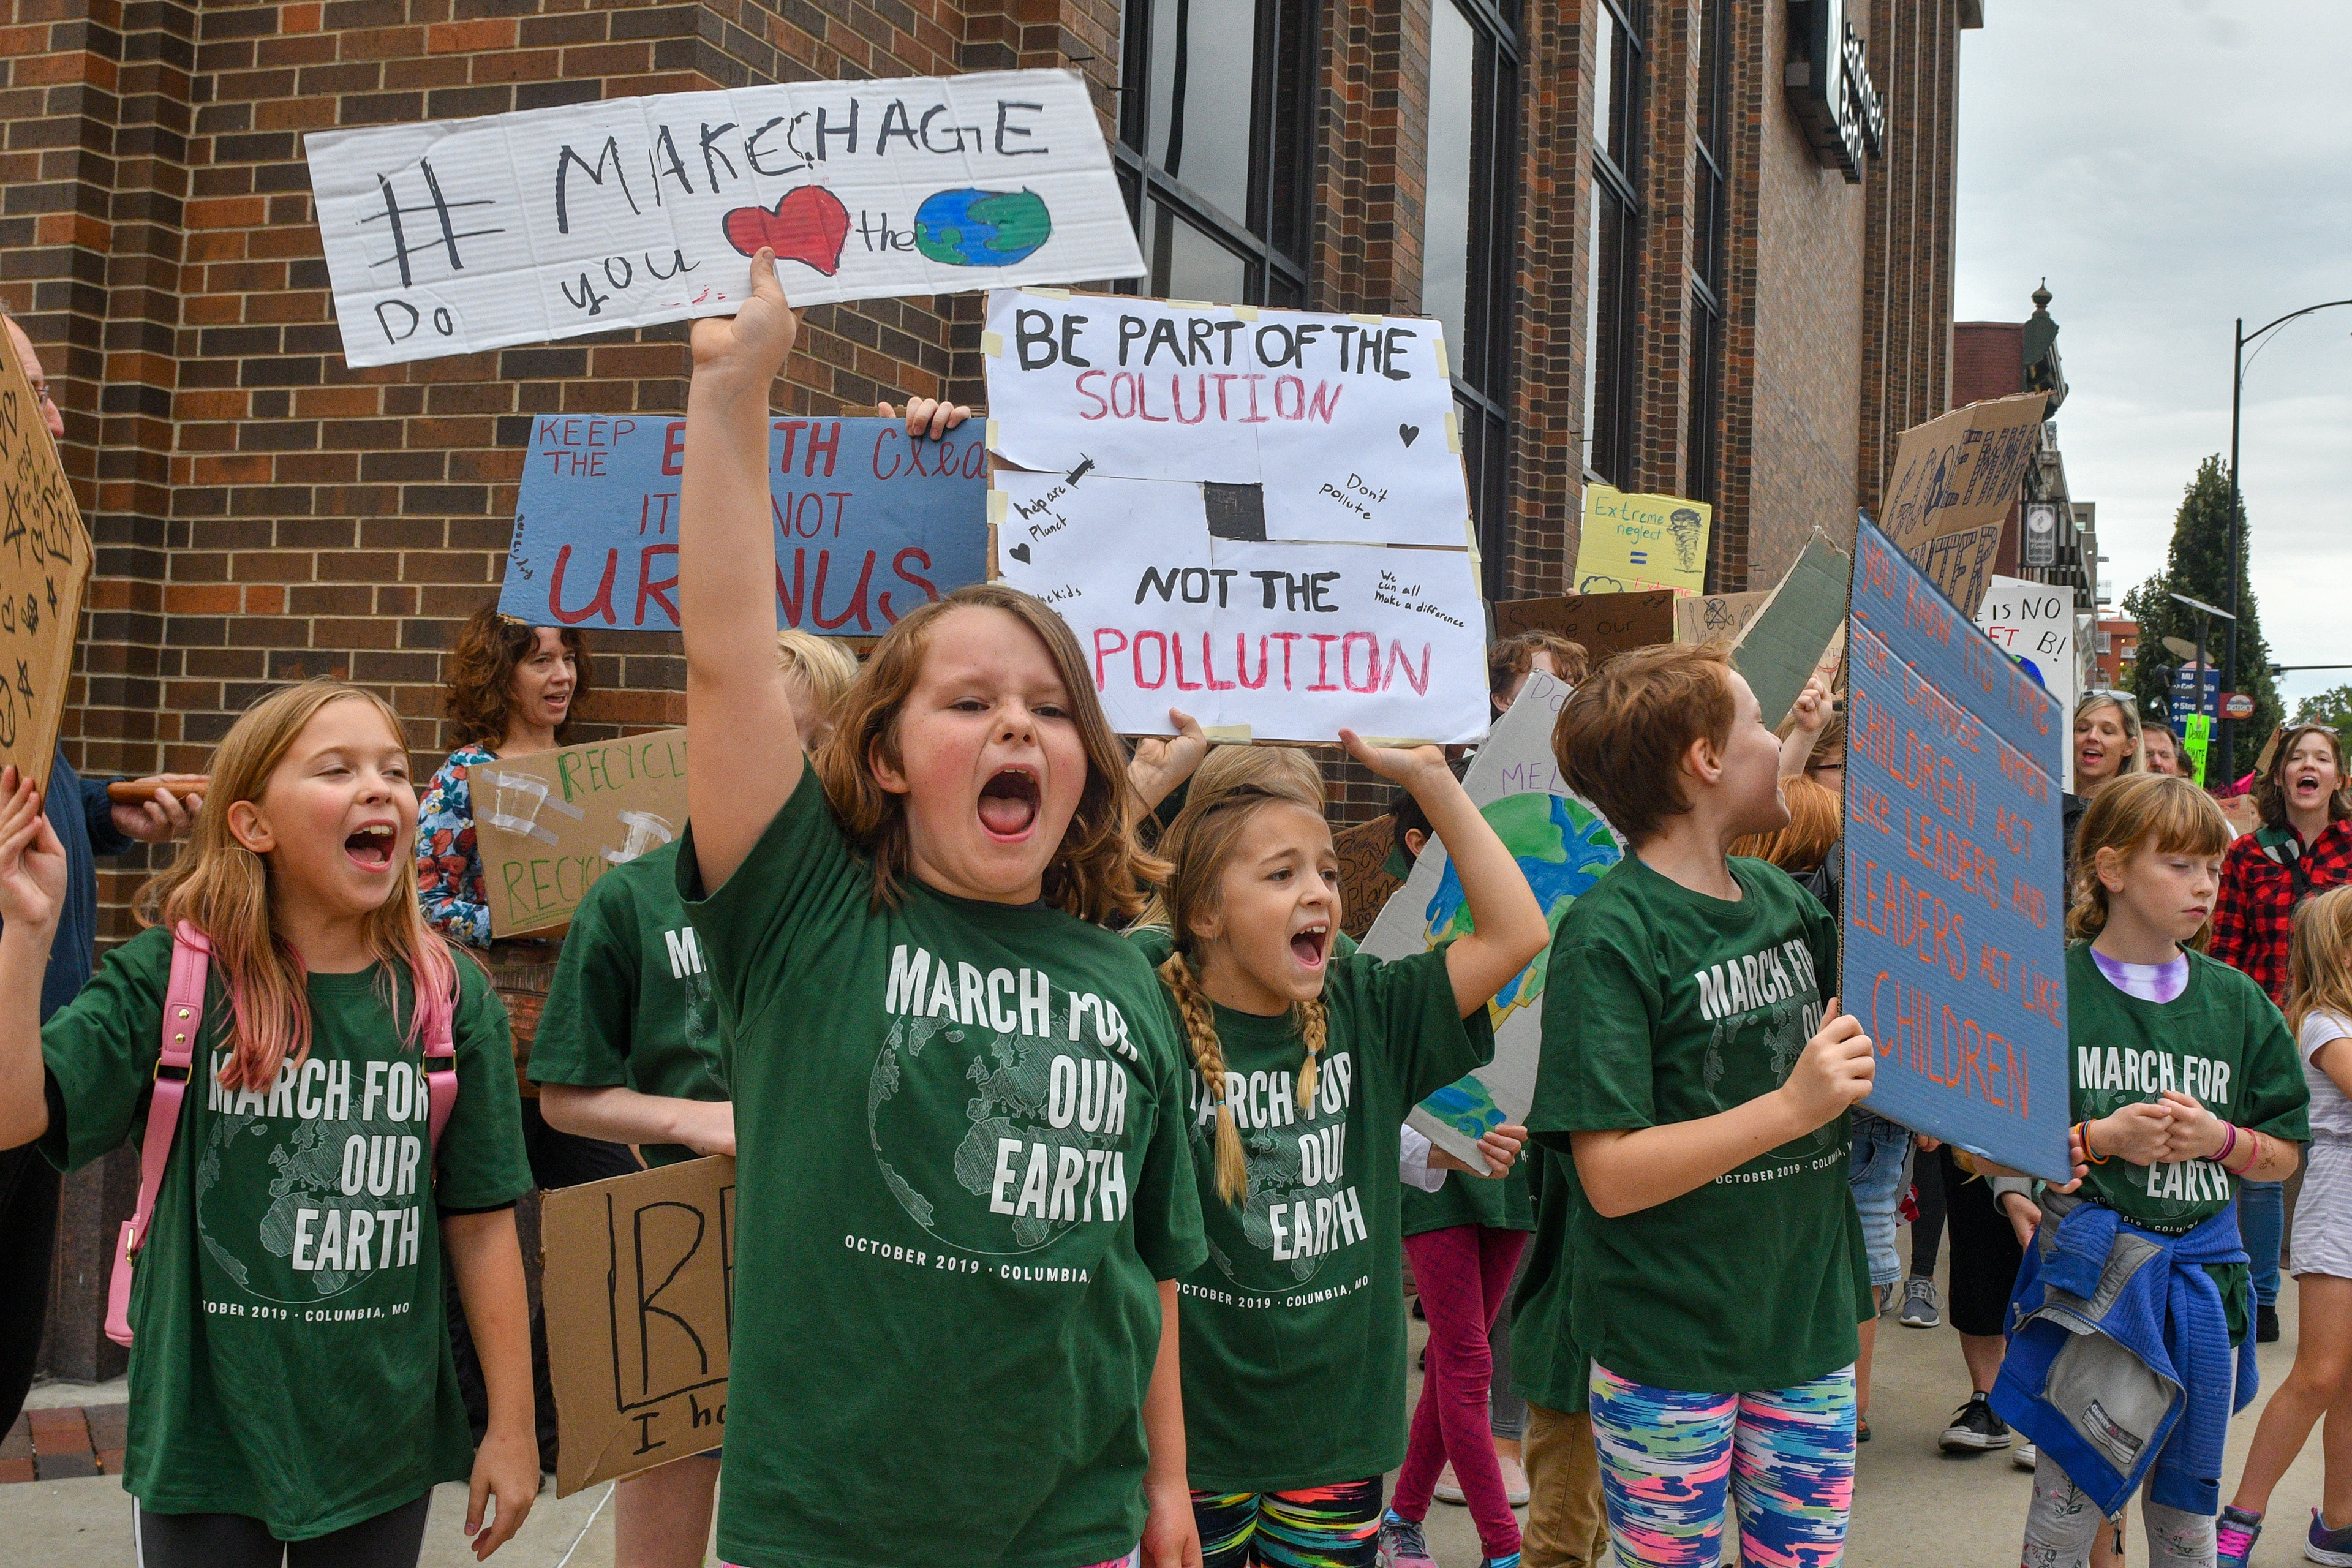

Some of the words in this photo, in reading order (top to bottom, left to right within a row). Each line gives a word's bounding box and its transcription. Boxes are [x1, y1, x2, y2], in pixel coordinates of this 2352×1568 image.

[1840, 74, 1864, 183] Bank
[374, 298, 454, 345] Do
[560, 249, 701, 316] you
[855, 211, 917, 252] the
[1016, 309, 1090, 371] BE
[1118, 314, 1246, 368] PART
[1255, 323, 1324, 369] OF
[1330, 325, 1417, 381] THE
[1075, 369, 1343, 426] SOLUTION
[539, 420, 635, 447] KEEP
[662, 421, 840, 477] ETH
[544, 451, 608, 477] THE
[772, 492, 852, 538] NOT
[1012, 499, 1052, 520] help
[1346, 473, 1387, 503] Don't
[1595, 496, 1664, 525] Extreme
[1616, 524, 1662, 545] neglect
[549, 544, 938, 632] URNUS
[1134, 566, 1237, 609] NOT
[1250, 570, 1341, 612] THE
[1378, 582, 1396, 592] can
[1402, 584, 1420, 597] all
[1381, 569, 1396, 582] We
[1634, 576, 1692, 598] Extme
[1863, 536, 1896, 599] YOU
[1904, 574, 1953, 648] KNOW
[1964, 627, 1993, 693] ITS
[1992, 604, 2011, 620] IS
[2021, 597, 2061, 620] NO
[1093, 628, 1431, 698] POLLUTION
[2037, 631, 2067, 662] B!
[1853, 611, 1890, 680] FOR
[1903, 661, 1981, 754] CHANGE
[2180, 702, 2214, 711] Stepns
[557, 741, 687, 804] RECYCL
[1503, 763, 1575, 795] MEL
[1852, 690, 1976, 831] CHILDREN
[1995, 805, 2034, 861] ACT
[1905, 807, 2000, 910] LEADERS
[2012, 876, 2048, 929] AND
[1851, 850, 1968, 981] LEADERS
[1980, 942, 2011, 993] ACT
[885, 944, 1050, 1038] MARCH
[1694, 946, 1795, 1021] MARCH
[1872, 970, 2029, 1120] CHILDREN
[362, 1060, 428, 1123] FOR
[1047, 1054, 1128, 1136] OUR
[2078, 1046, 2176, 1095] MARCH
[2183, 1054, 2231, 1104] FOR
[341, 1134, 421, 1197] OUR
[989, 1137, 1128, 1223] EARTH
[1714, 1170, 1774, 1185] OCTOBER
[1777, 1163, 1800, 1178] 2019
[2146, 1159, 2230, 1202] EARTH
[292, 1205, 420, 1271] EARTH
[1268, 1185, 1368, 1262] EARTH
[844, 1234, 927, 1267] OCTOBER
[935, 1254, 979, 1275] 2019
[1000, 1264, 1092, 1286] COLUMBIA,
[251, 1305, 287, 1321] 2019
[305, 1307, 385, 1322] COLUMBIA,
[392, 1302, 410, 1315] MO
[1238, 1297, 1271, 1310] 2019
[1286, 1284, 1352, 1308] COLUMBIA,
[1354, 1274, 1369, 1291] MO
[632, 1412, 666, 1455] I
